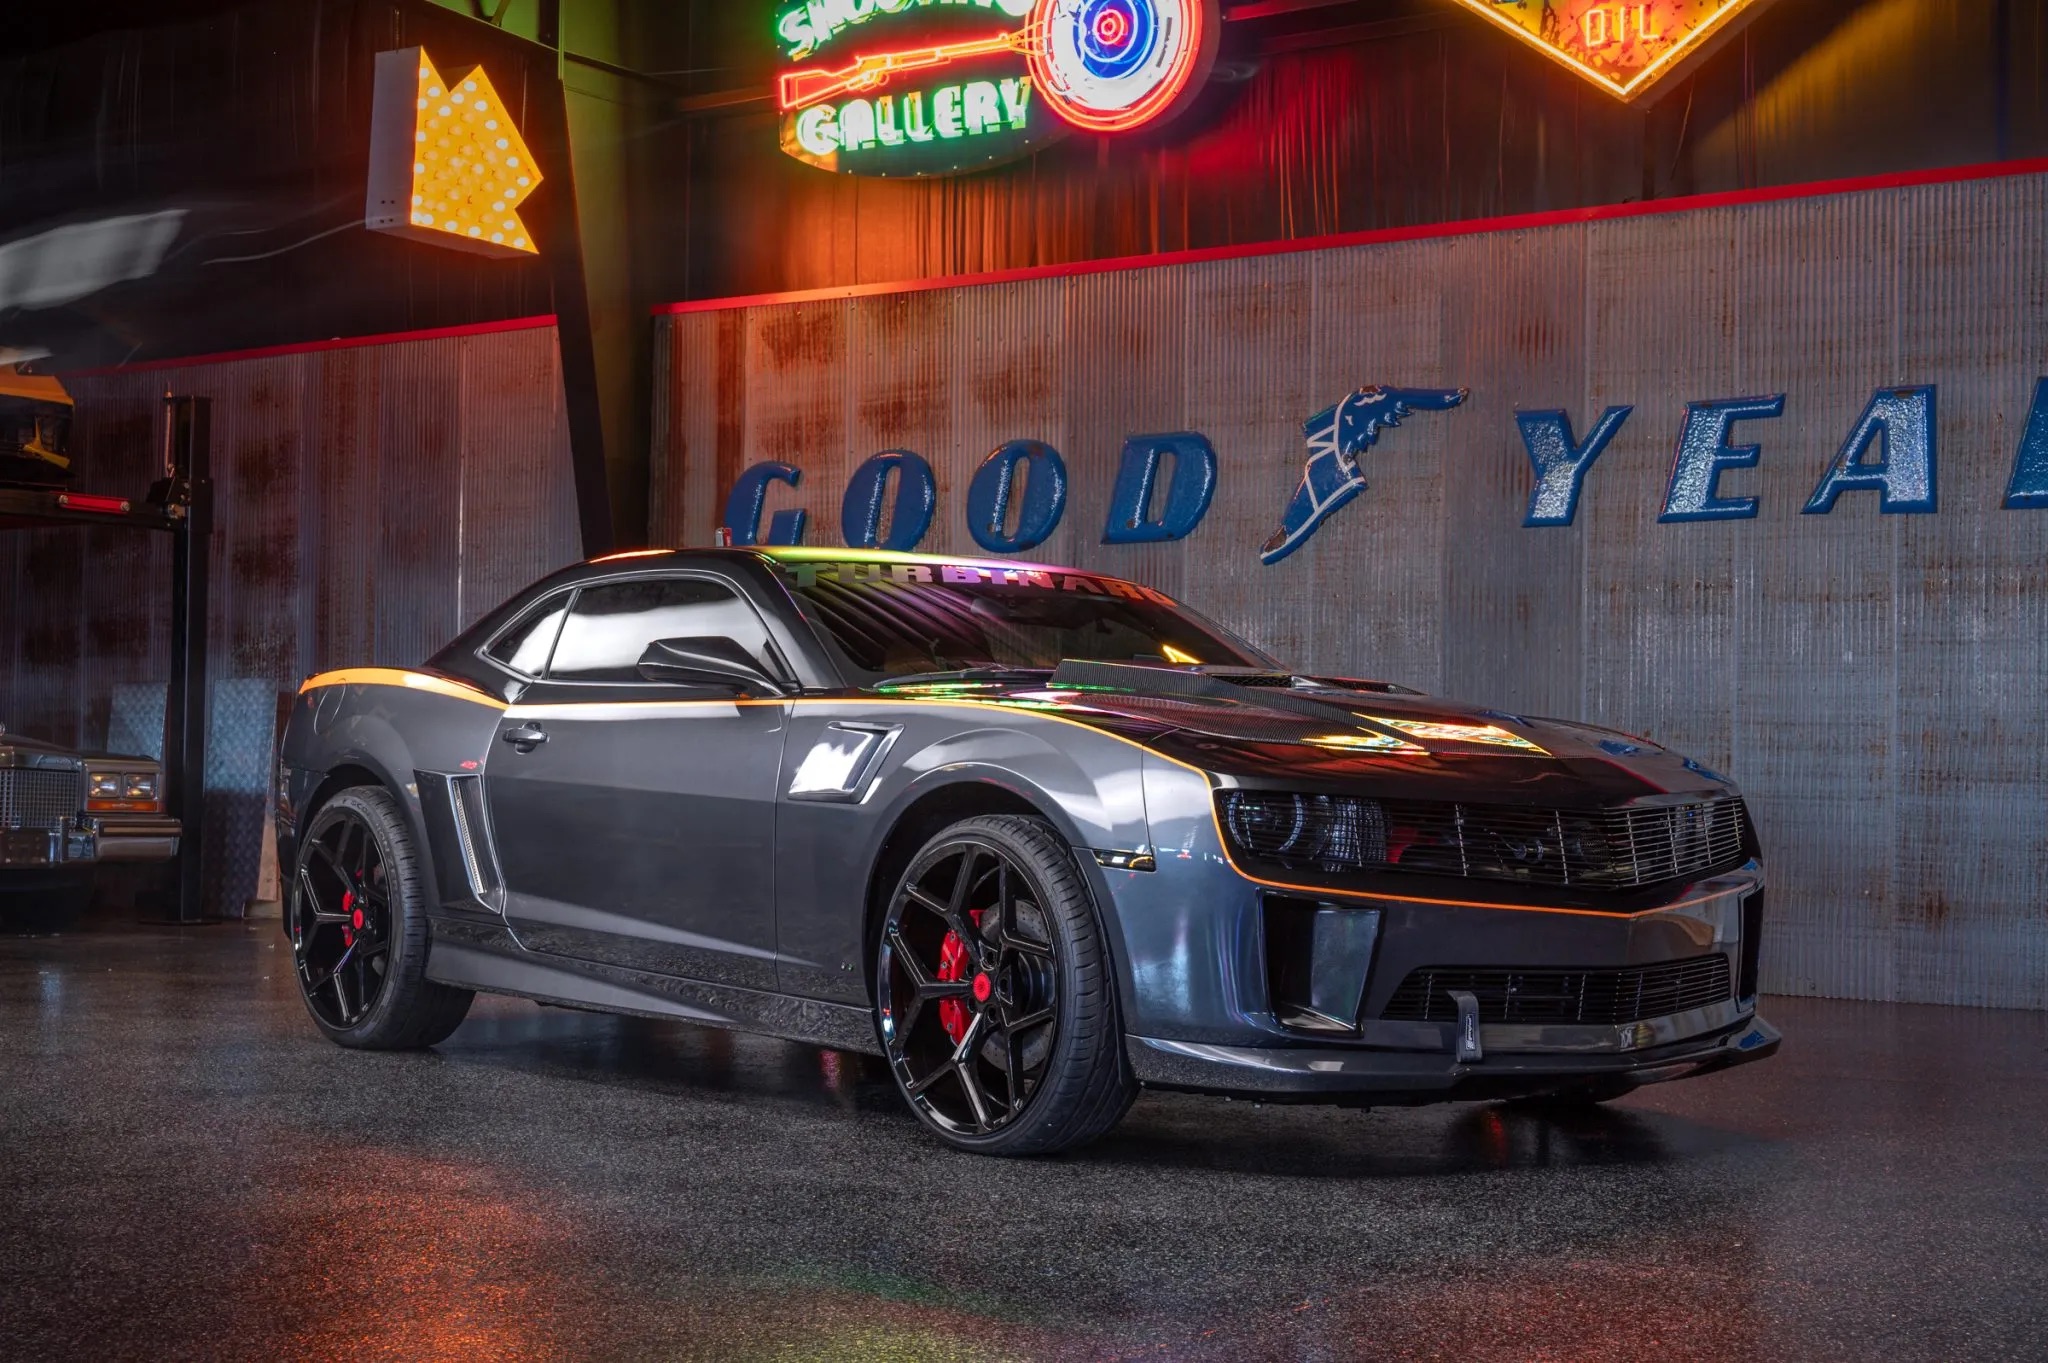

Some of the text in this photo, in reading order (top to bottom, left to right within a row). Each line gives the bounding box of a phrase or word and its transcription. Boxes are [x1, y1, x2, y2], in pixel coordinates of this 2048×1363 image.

[1585, 4, 1661, 47] OIL
[796, 76, 1031, 155] GALLERY
[723, 431, 1217, 553] GOOD
